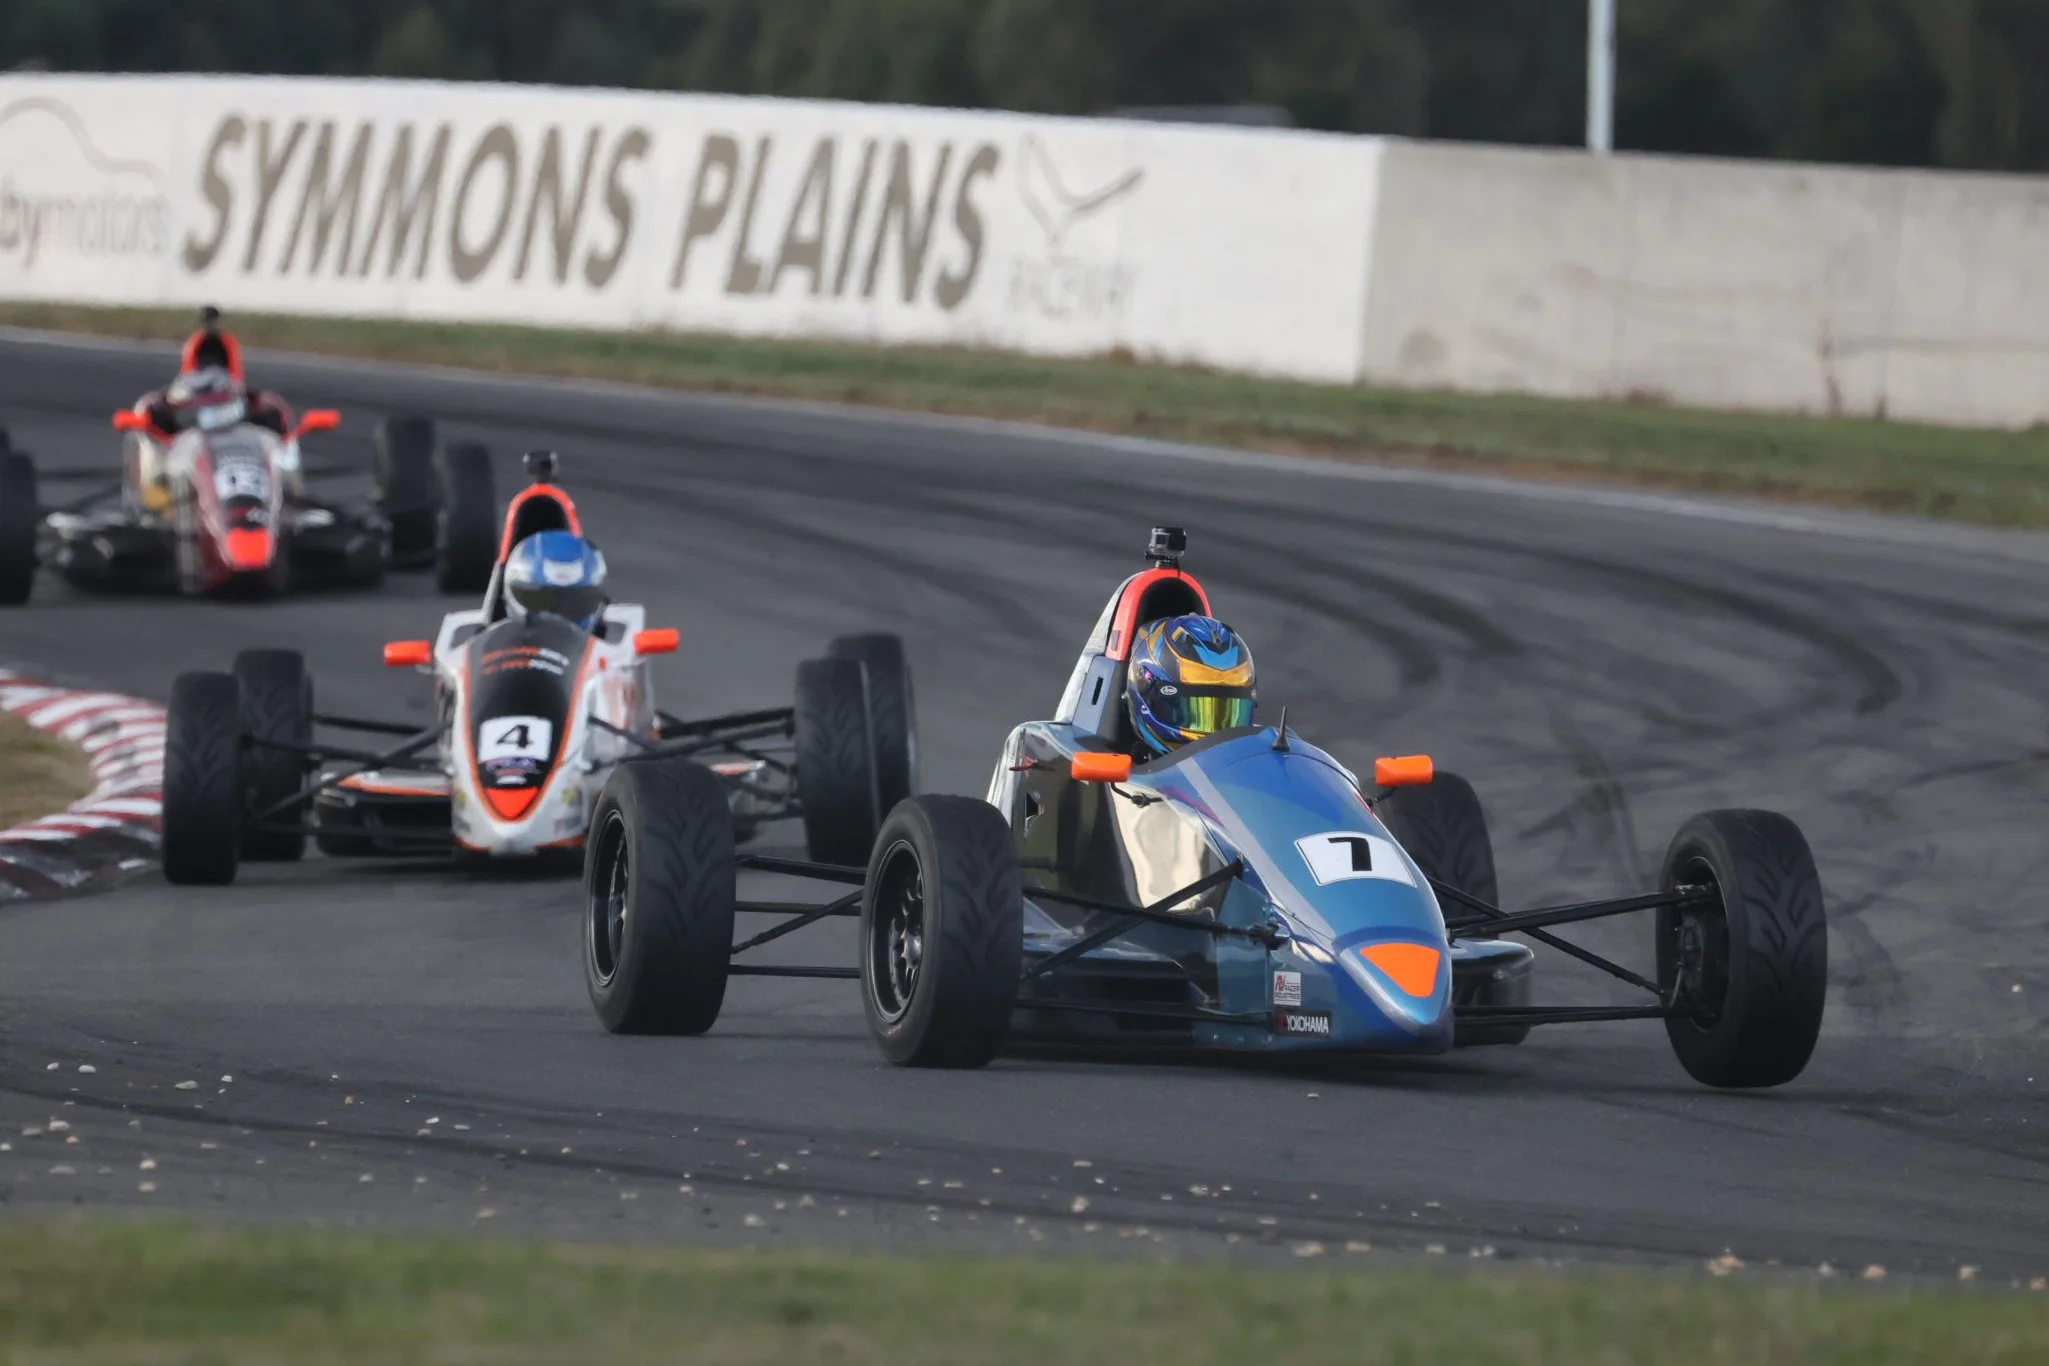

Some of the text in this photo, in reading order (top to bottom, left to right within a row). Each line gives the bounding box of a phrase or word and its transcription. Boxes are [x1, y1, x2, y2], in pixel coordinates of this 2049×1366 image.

[182, 112, 999, 312] SYMMONS PLAINS
[495, 724, 533, 748] 4
[1286, 1015, 1330, 1034] YOKOHAMA
